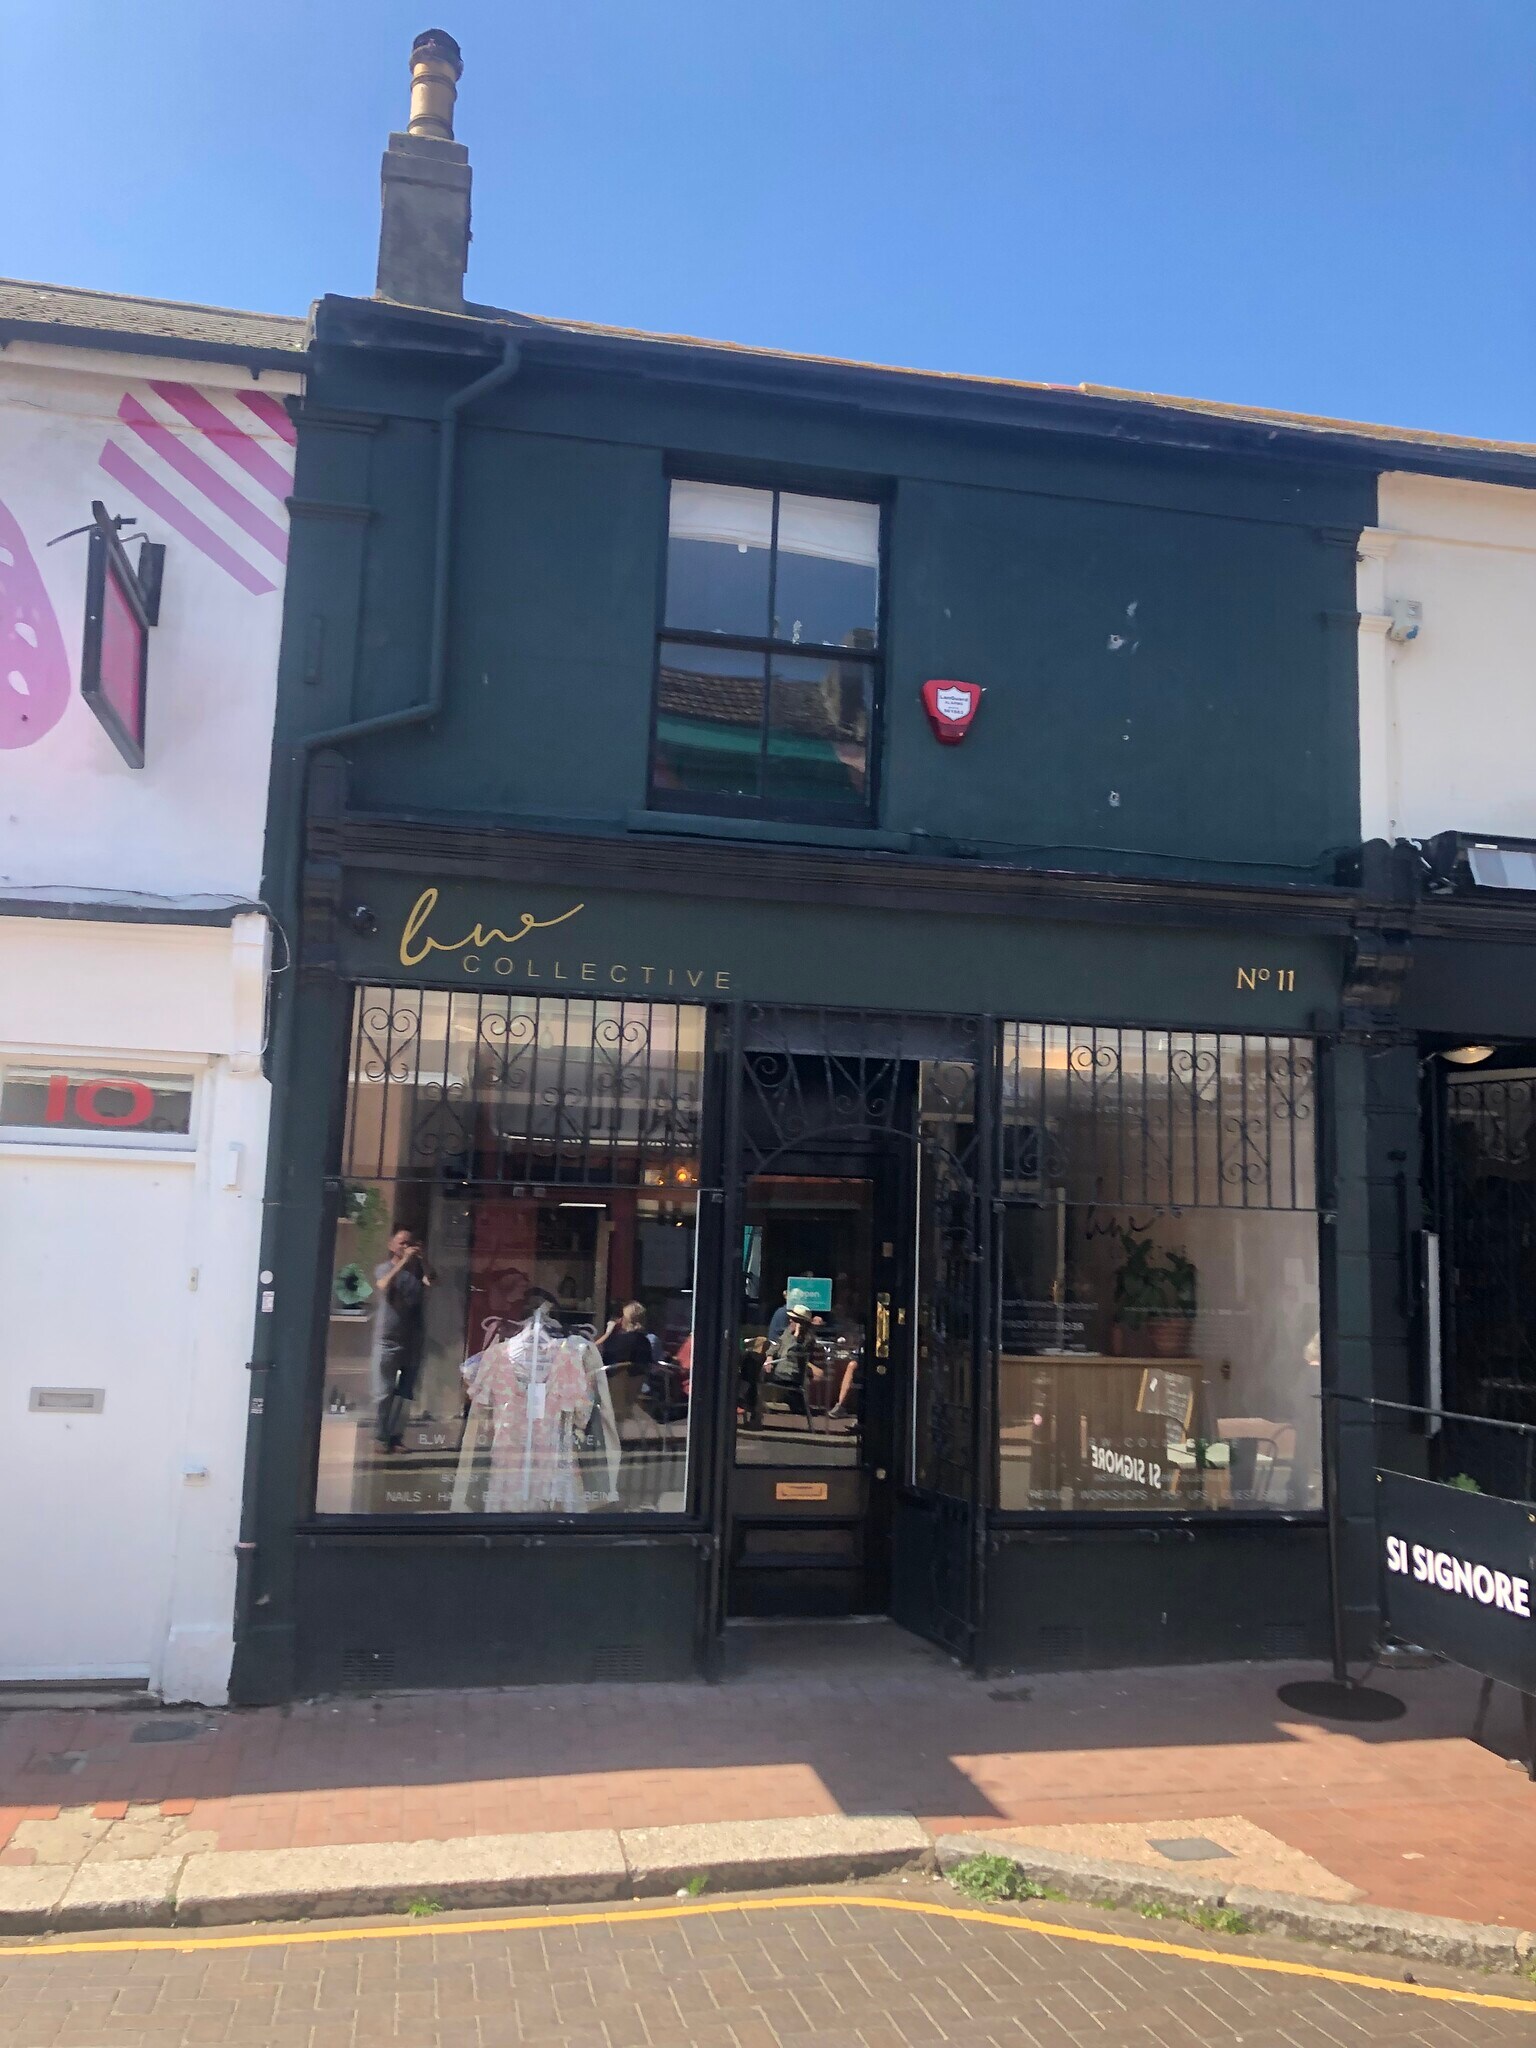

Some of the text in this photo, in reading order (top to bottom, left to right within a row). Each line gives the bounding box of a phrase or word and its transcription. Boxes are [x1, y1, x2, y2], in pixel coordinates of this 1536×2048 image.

[462, 954, 732, 990] COLLECTIVE
[1277, 969, 1295, 992] 11
[45, 1074, 155, 1127] 10
[385, 1490, 422, 1503] NAILS
[1386, 1535, 1531, 1618] SI SIGNORE
